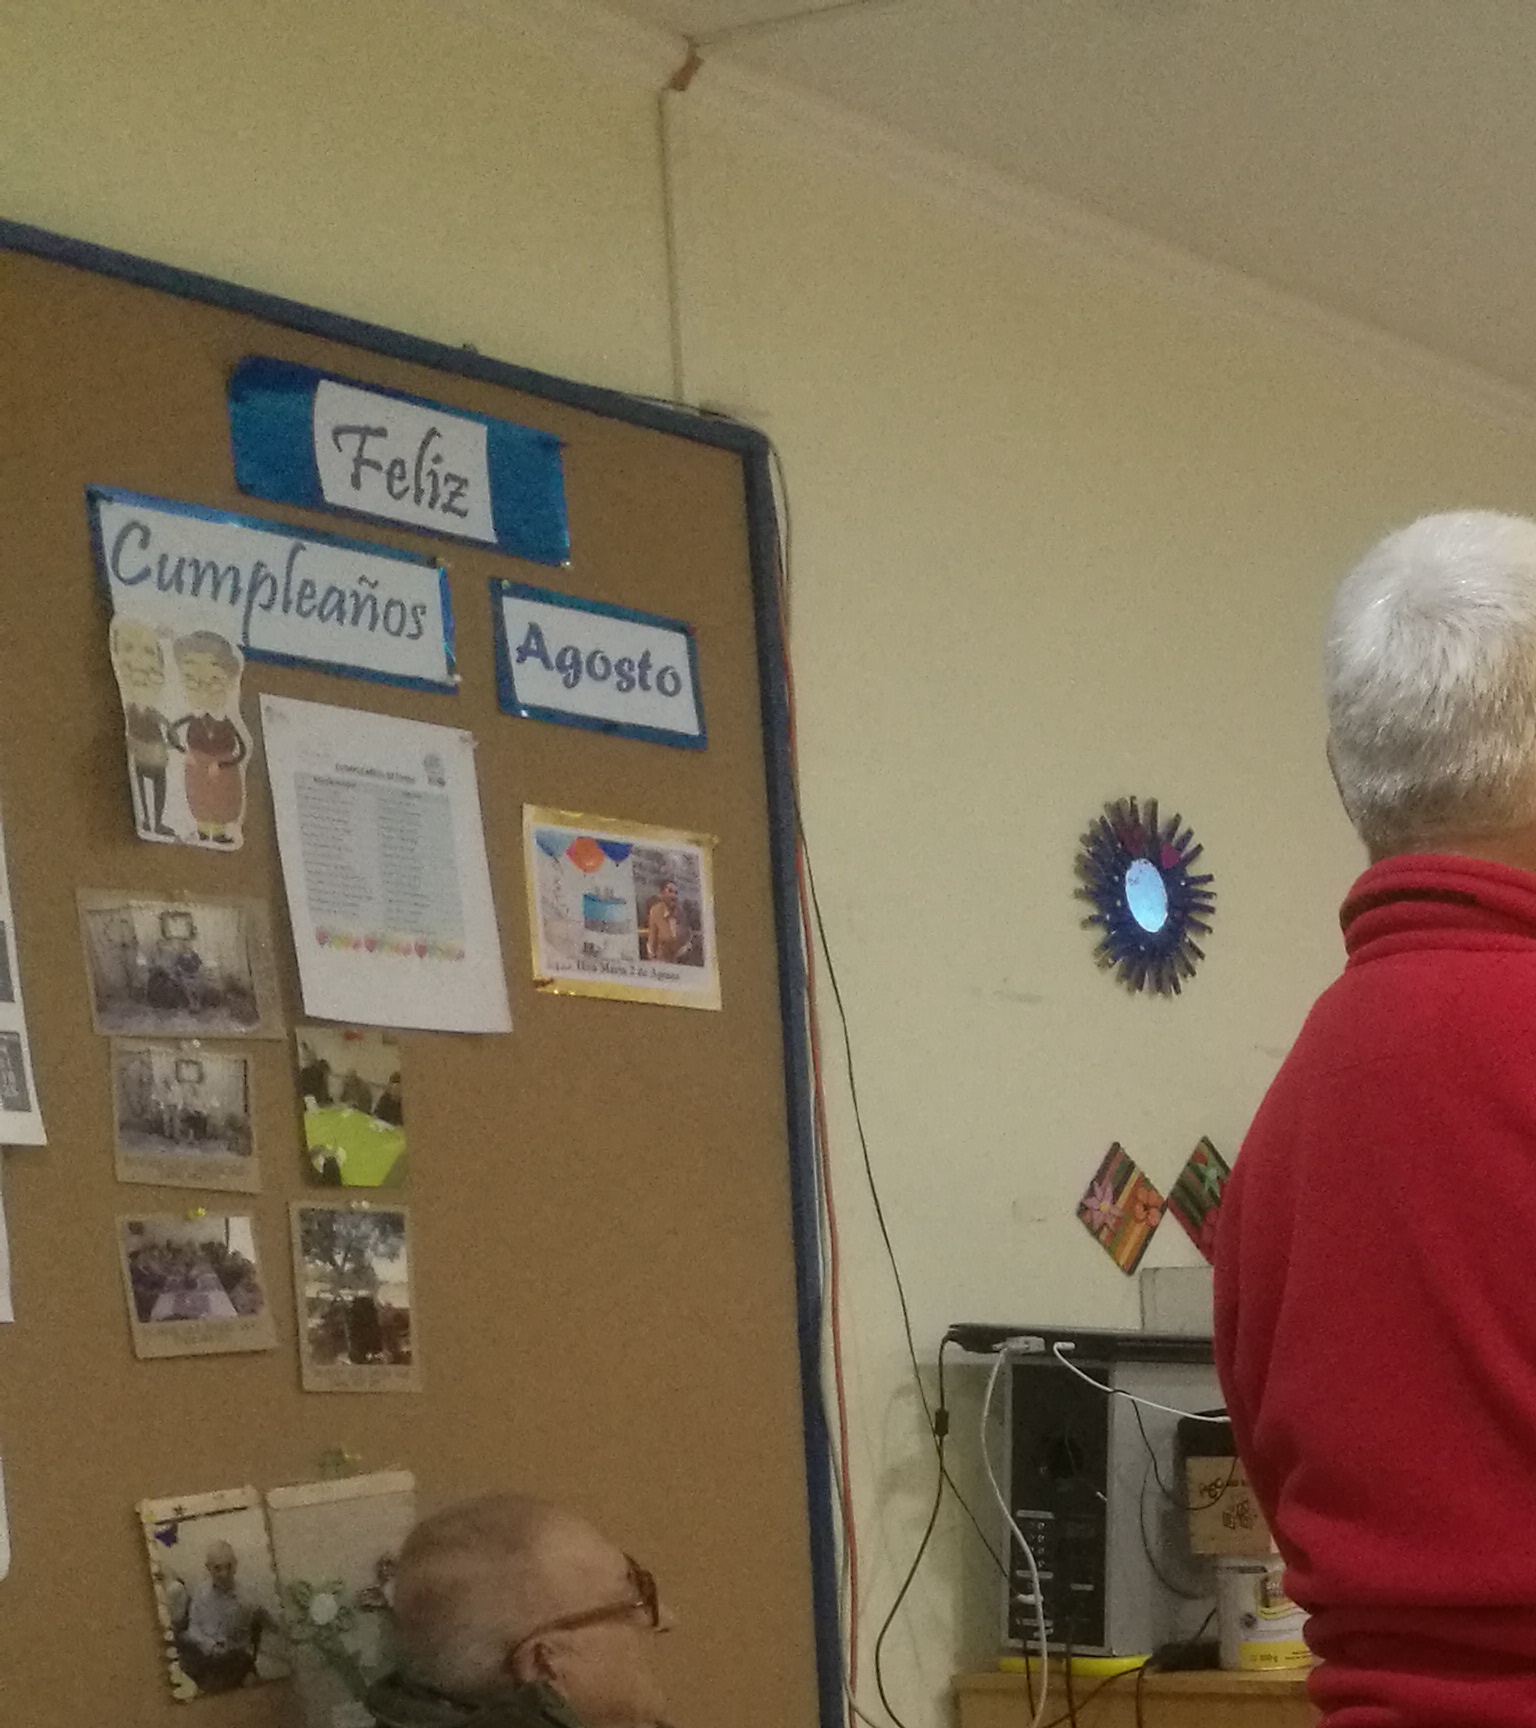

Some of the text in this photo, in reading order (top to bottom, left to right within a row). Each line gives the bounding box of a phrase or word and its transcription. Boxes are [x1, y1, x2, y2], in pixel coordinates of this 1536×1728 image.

[331, 423, 470, 519] Feliz
[110, 519, 427, 649] Cumpleaños
[515, 622, 683, 699] Agosto
